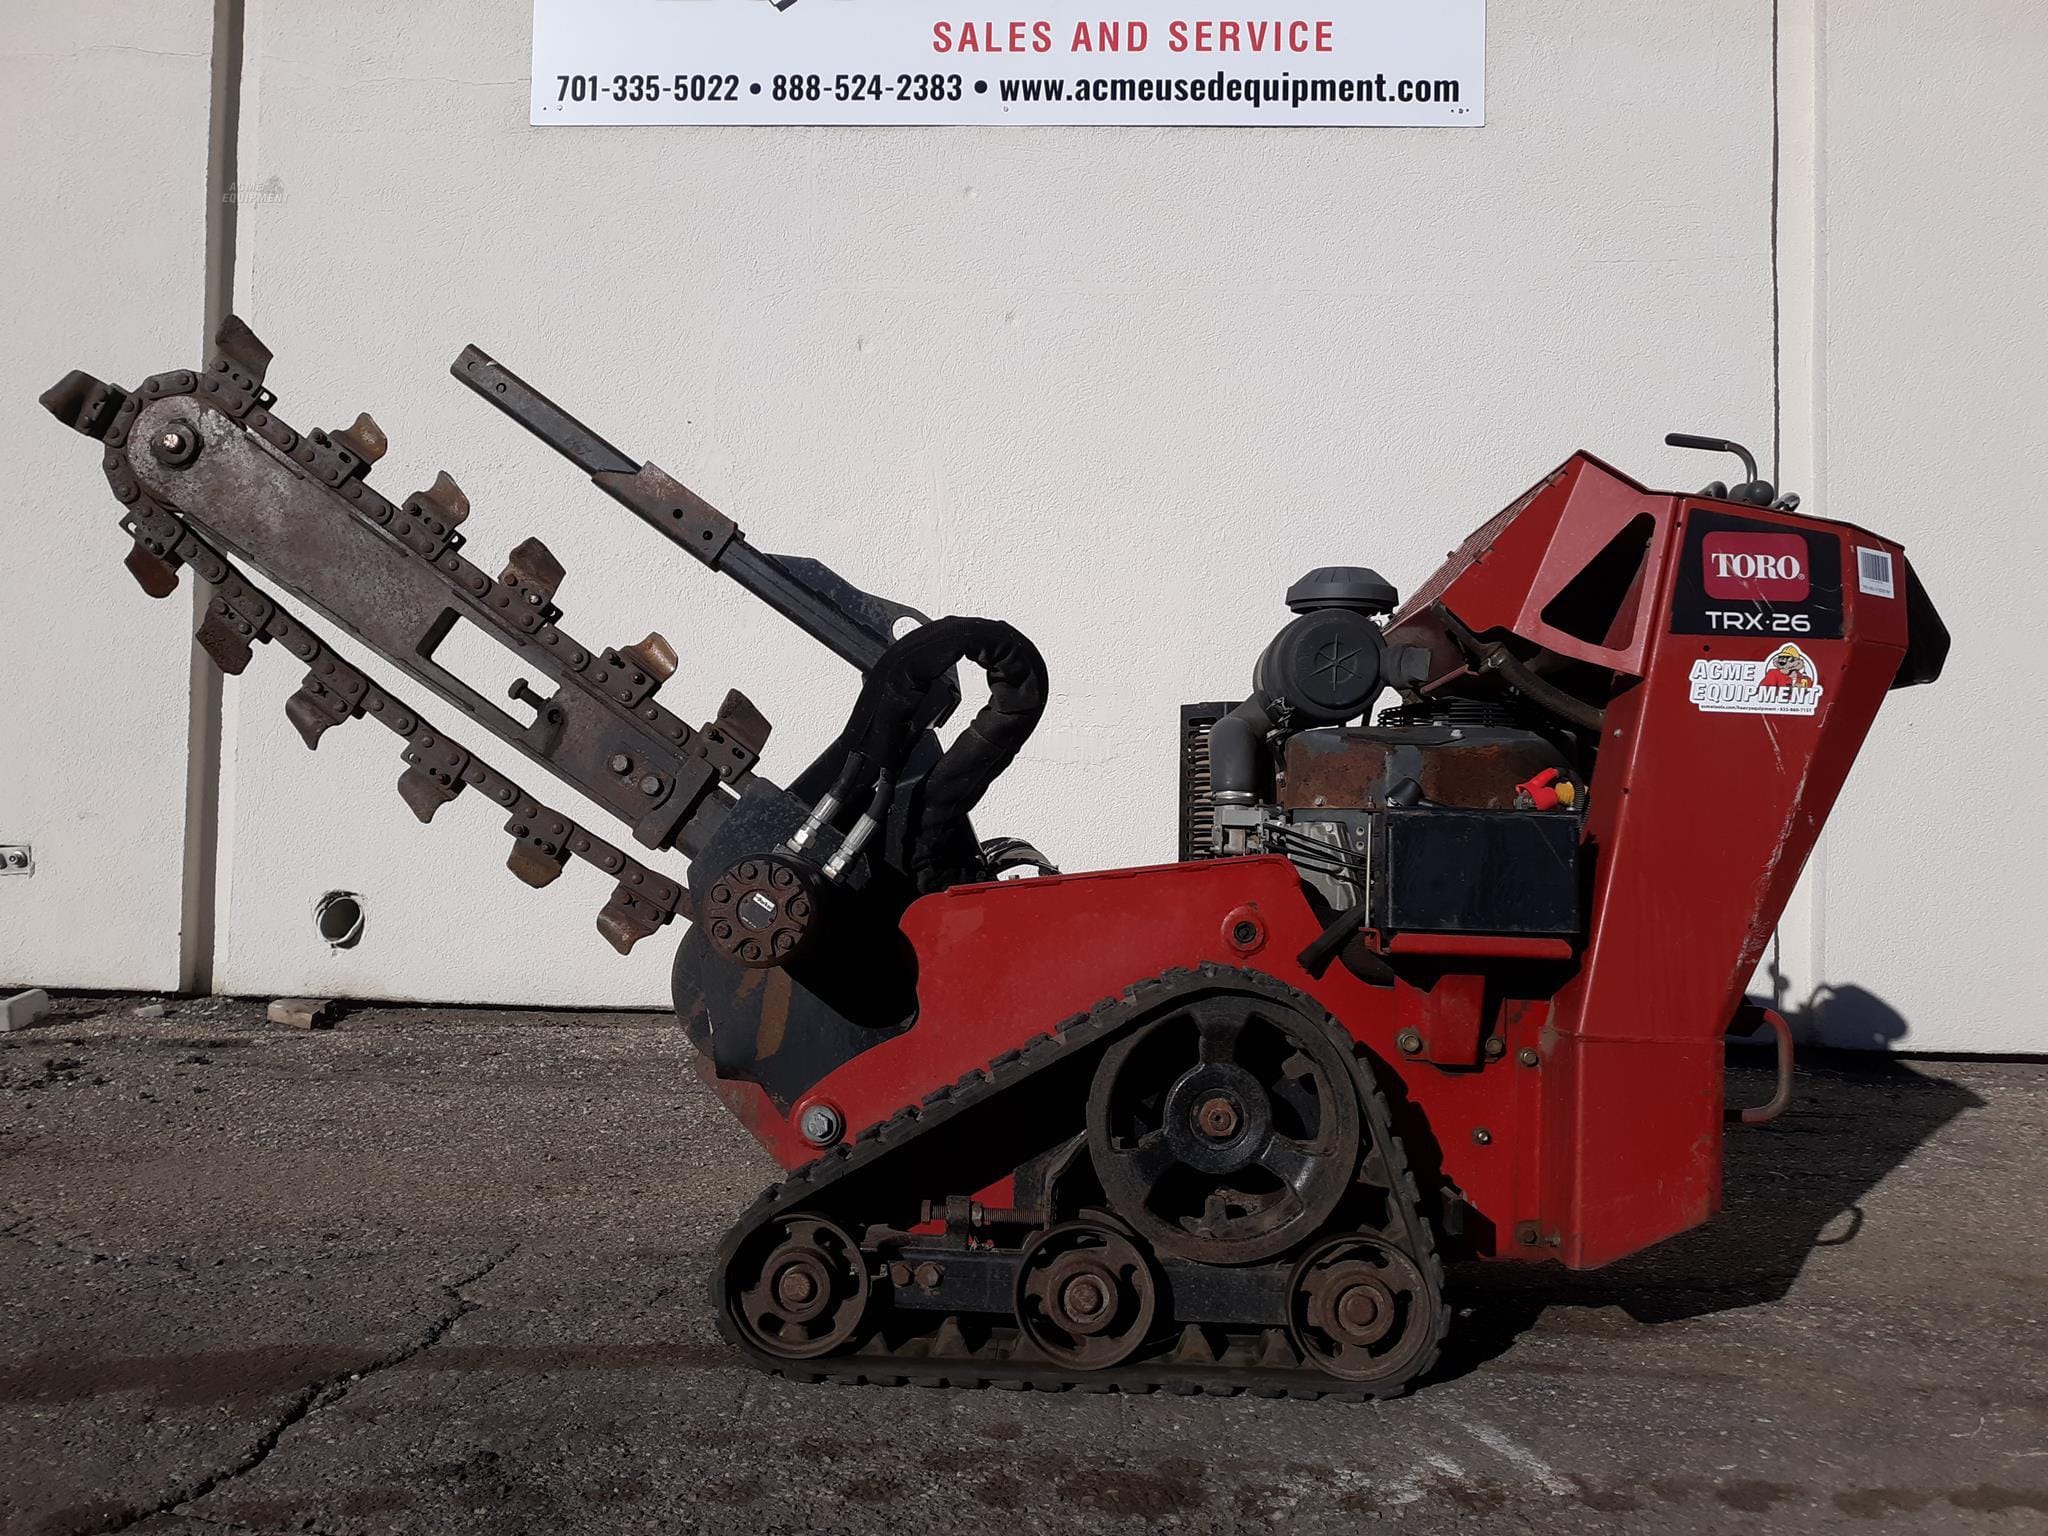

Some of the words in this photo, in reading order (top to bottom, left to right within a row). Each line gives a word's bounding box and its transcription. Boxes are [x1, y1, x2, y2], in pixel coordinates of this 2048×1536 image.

[932, 20, 1052, 53] SALES
[1071, 20, 1148, 53] AND
[1168, 20, 1334, 53] SERVICE
[557, 74, 739, 102] 701-335-5022
[772, 74, 962, 101] 888-524-2383
[1000, 70, 1459, 108] www.acmeusedequipment.com
[1711, 553, 1801, 580] TORO
[1693, 661, 1756, 681] ACME
[1693, 683, 1820, 705] EQUIPMENT
